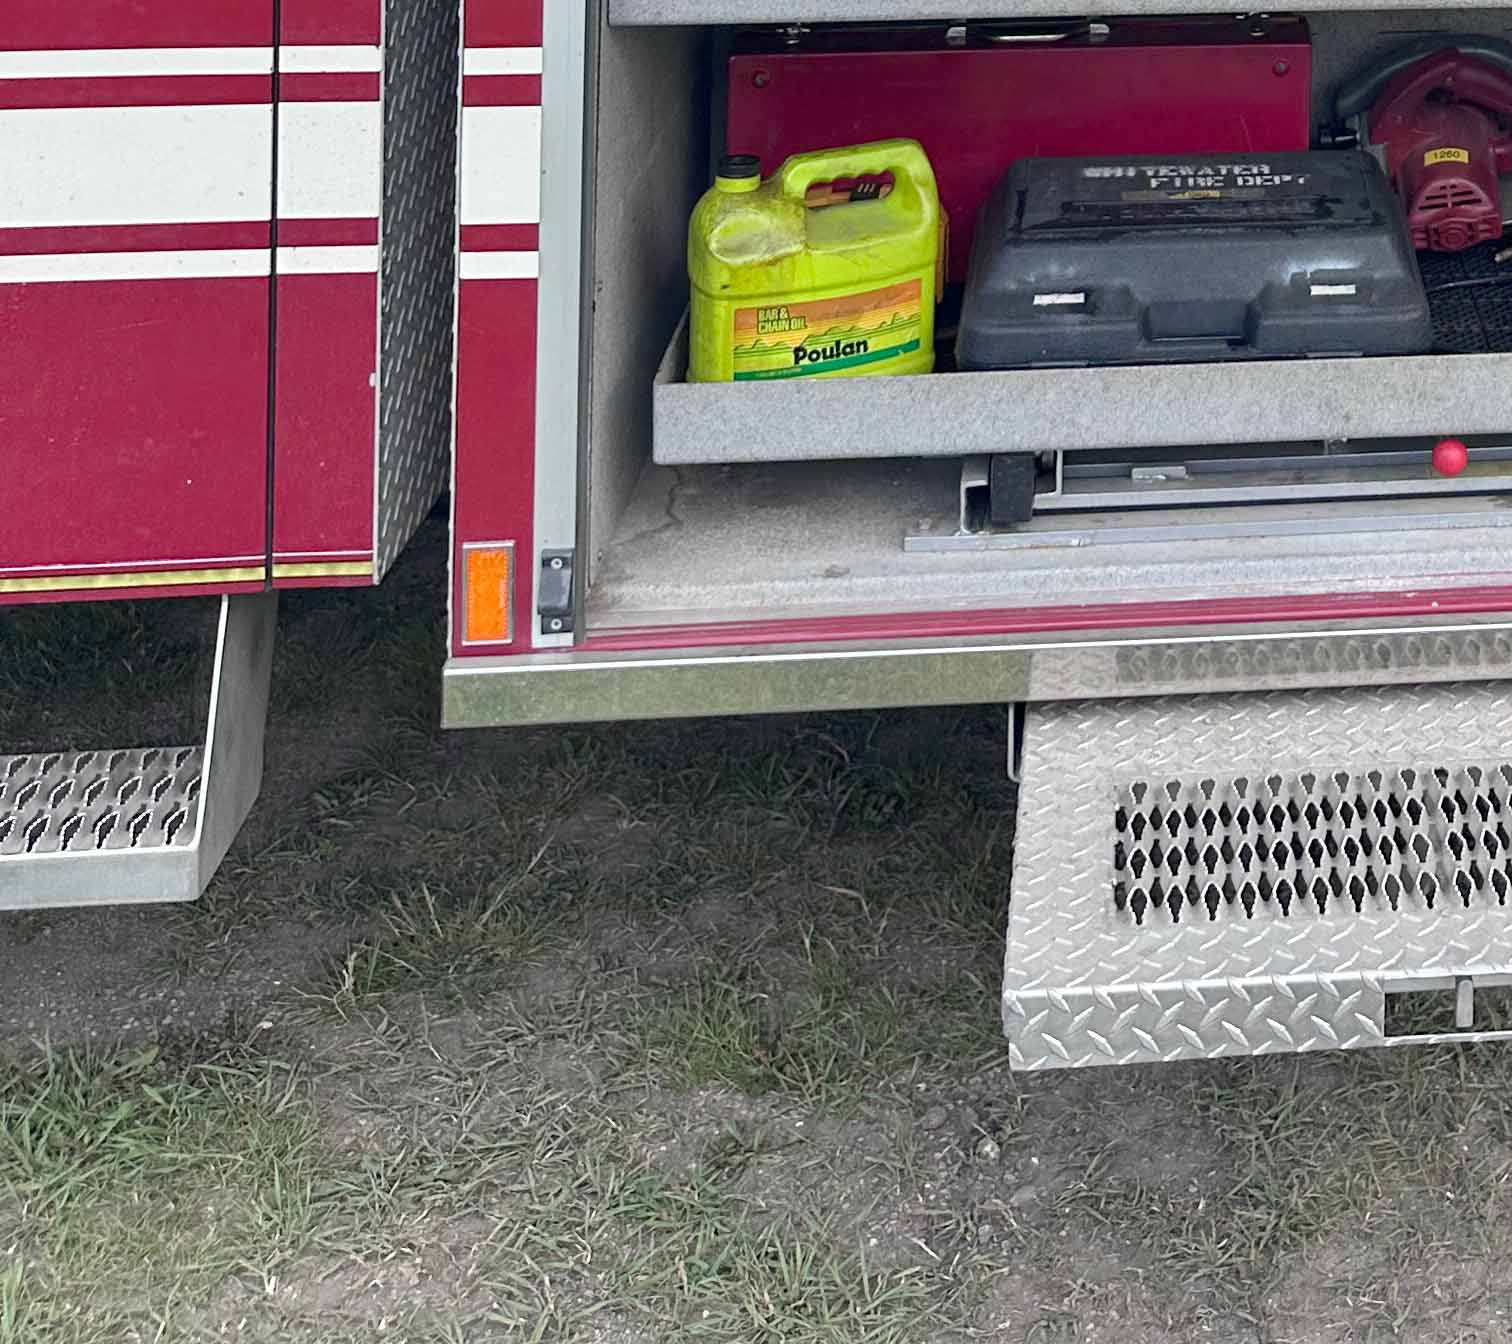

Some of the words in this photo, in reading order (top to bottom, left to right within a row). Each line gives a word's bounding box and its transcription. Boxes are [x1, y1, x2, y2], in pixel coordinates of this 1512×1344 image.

[1150, 175, 1225, 188] FIRE
[759, 309, 778, 321] BAR
[780, 307, 788, 319] &
[759, 319, 789, 333] CHAIN
[793, 339, 869, 365] Poulan
